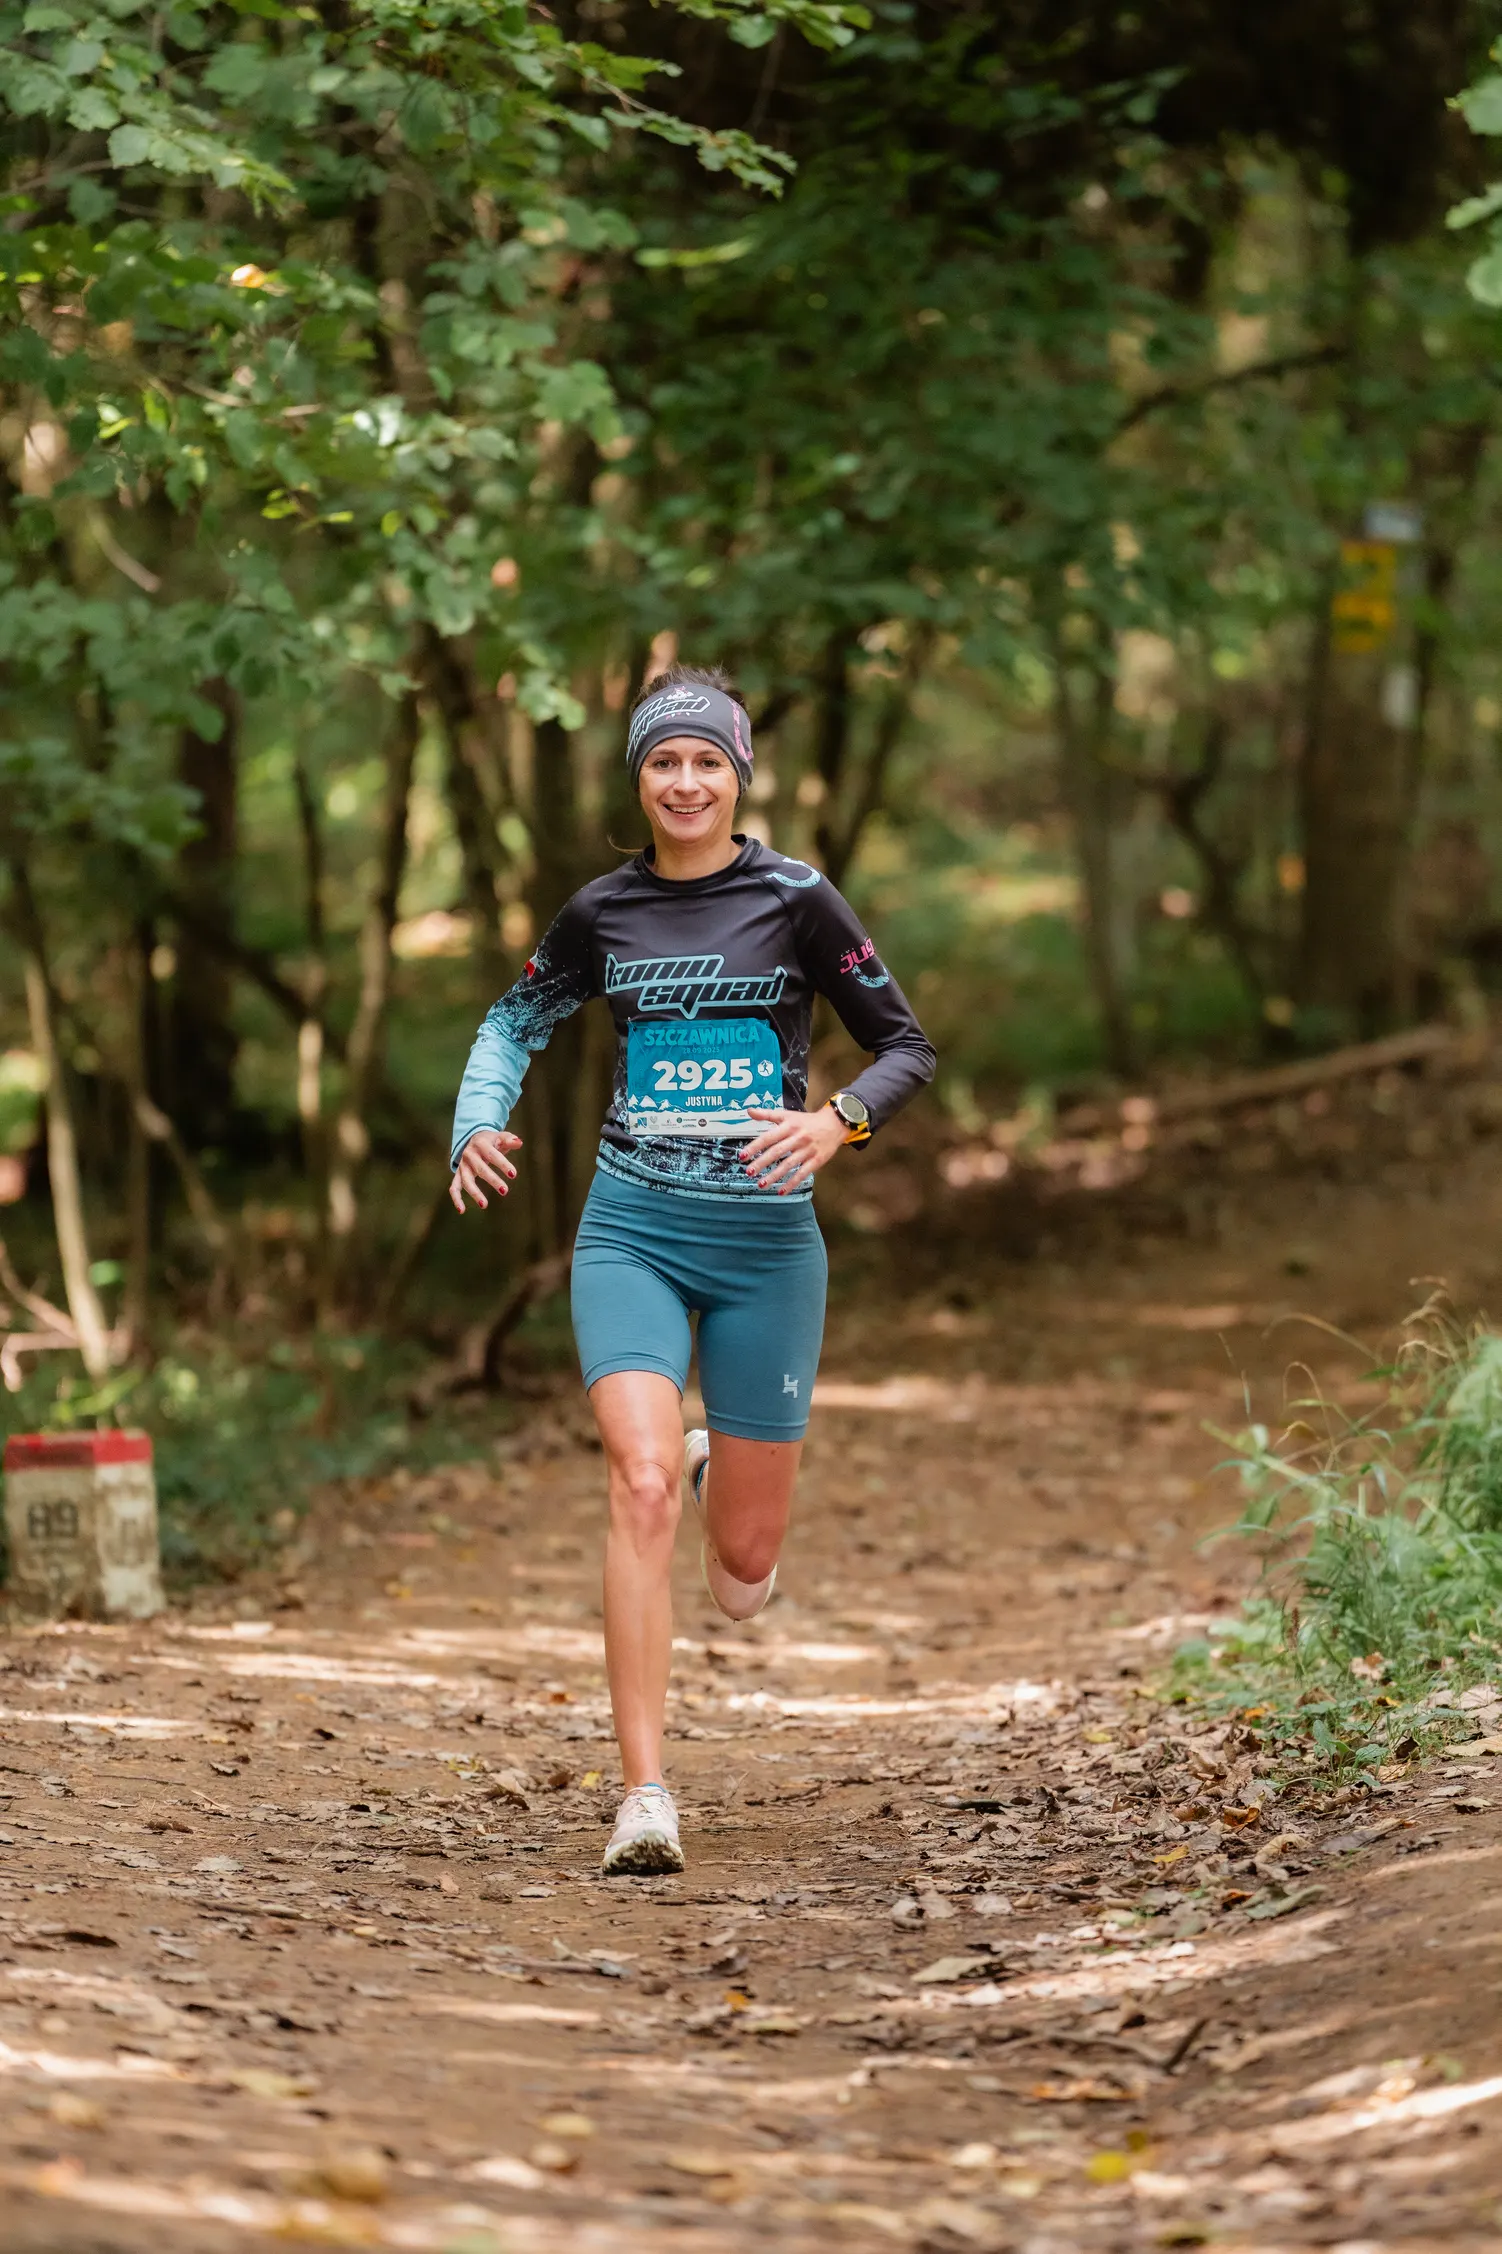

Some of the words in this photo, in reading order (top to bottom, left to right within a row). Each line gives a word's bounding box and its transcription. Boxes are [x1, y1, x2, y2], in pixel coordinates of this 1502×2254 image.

[643, 1025, 761, 1046] SZCZAWNICA
[651, 1057, 753, 1091] 2925
[685, 1095, 723, 1107] JUSTYNA
